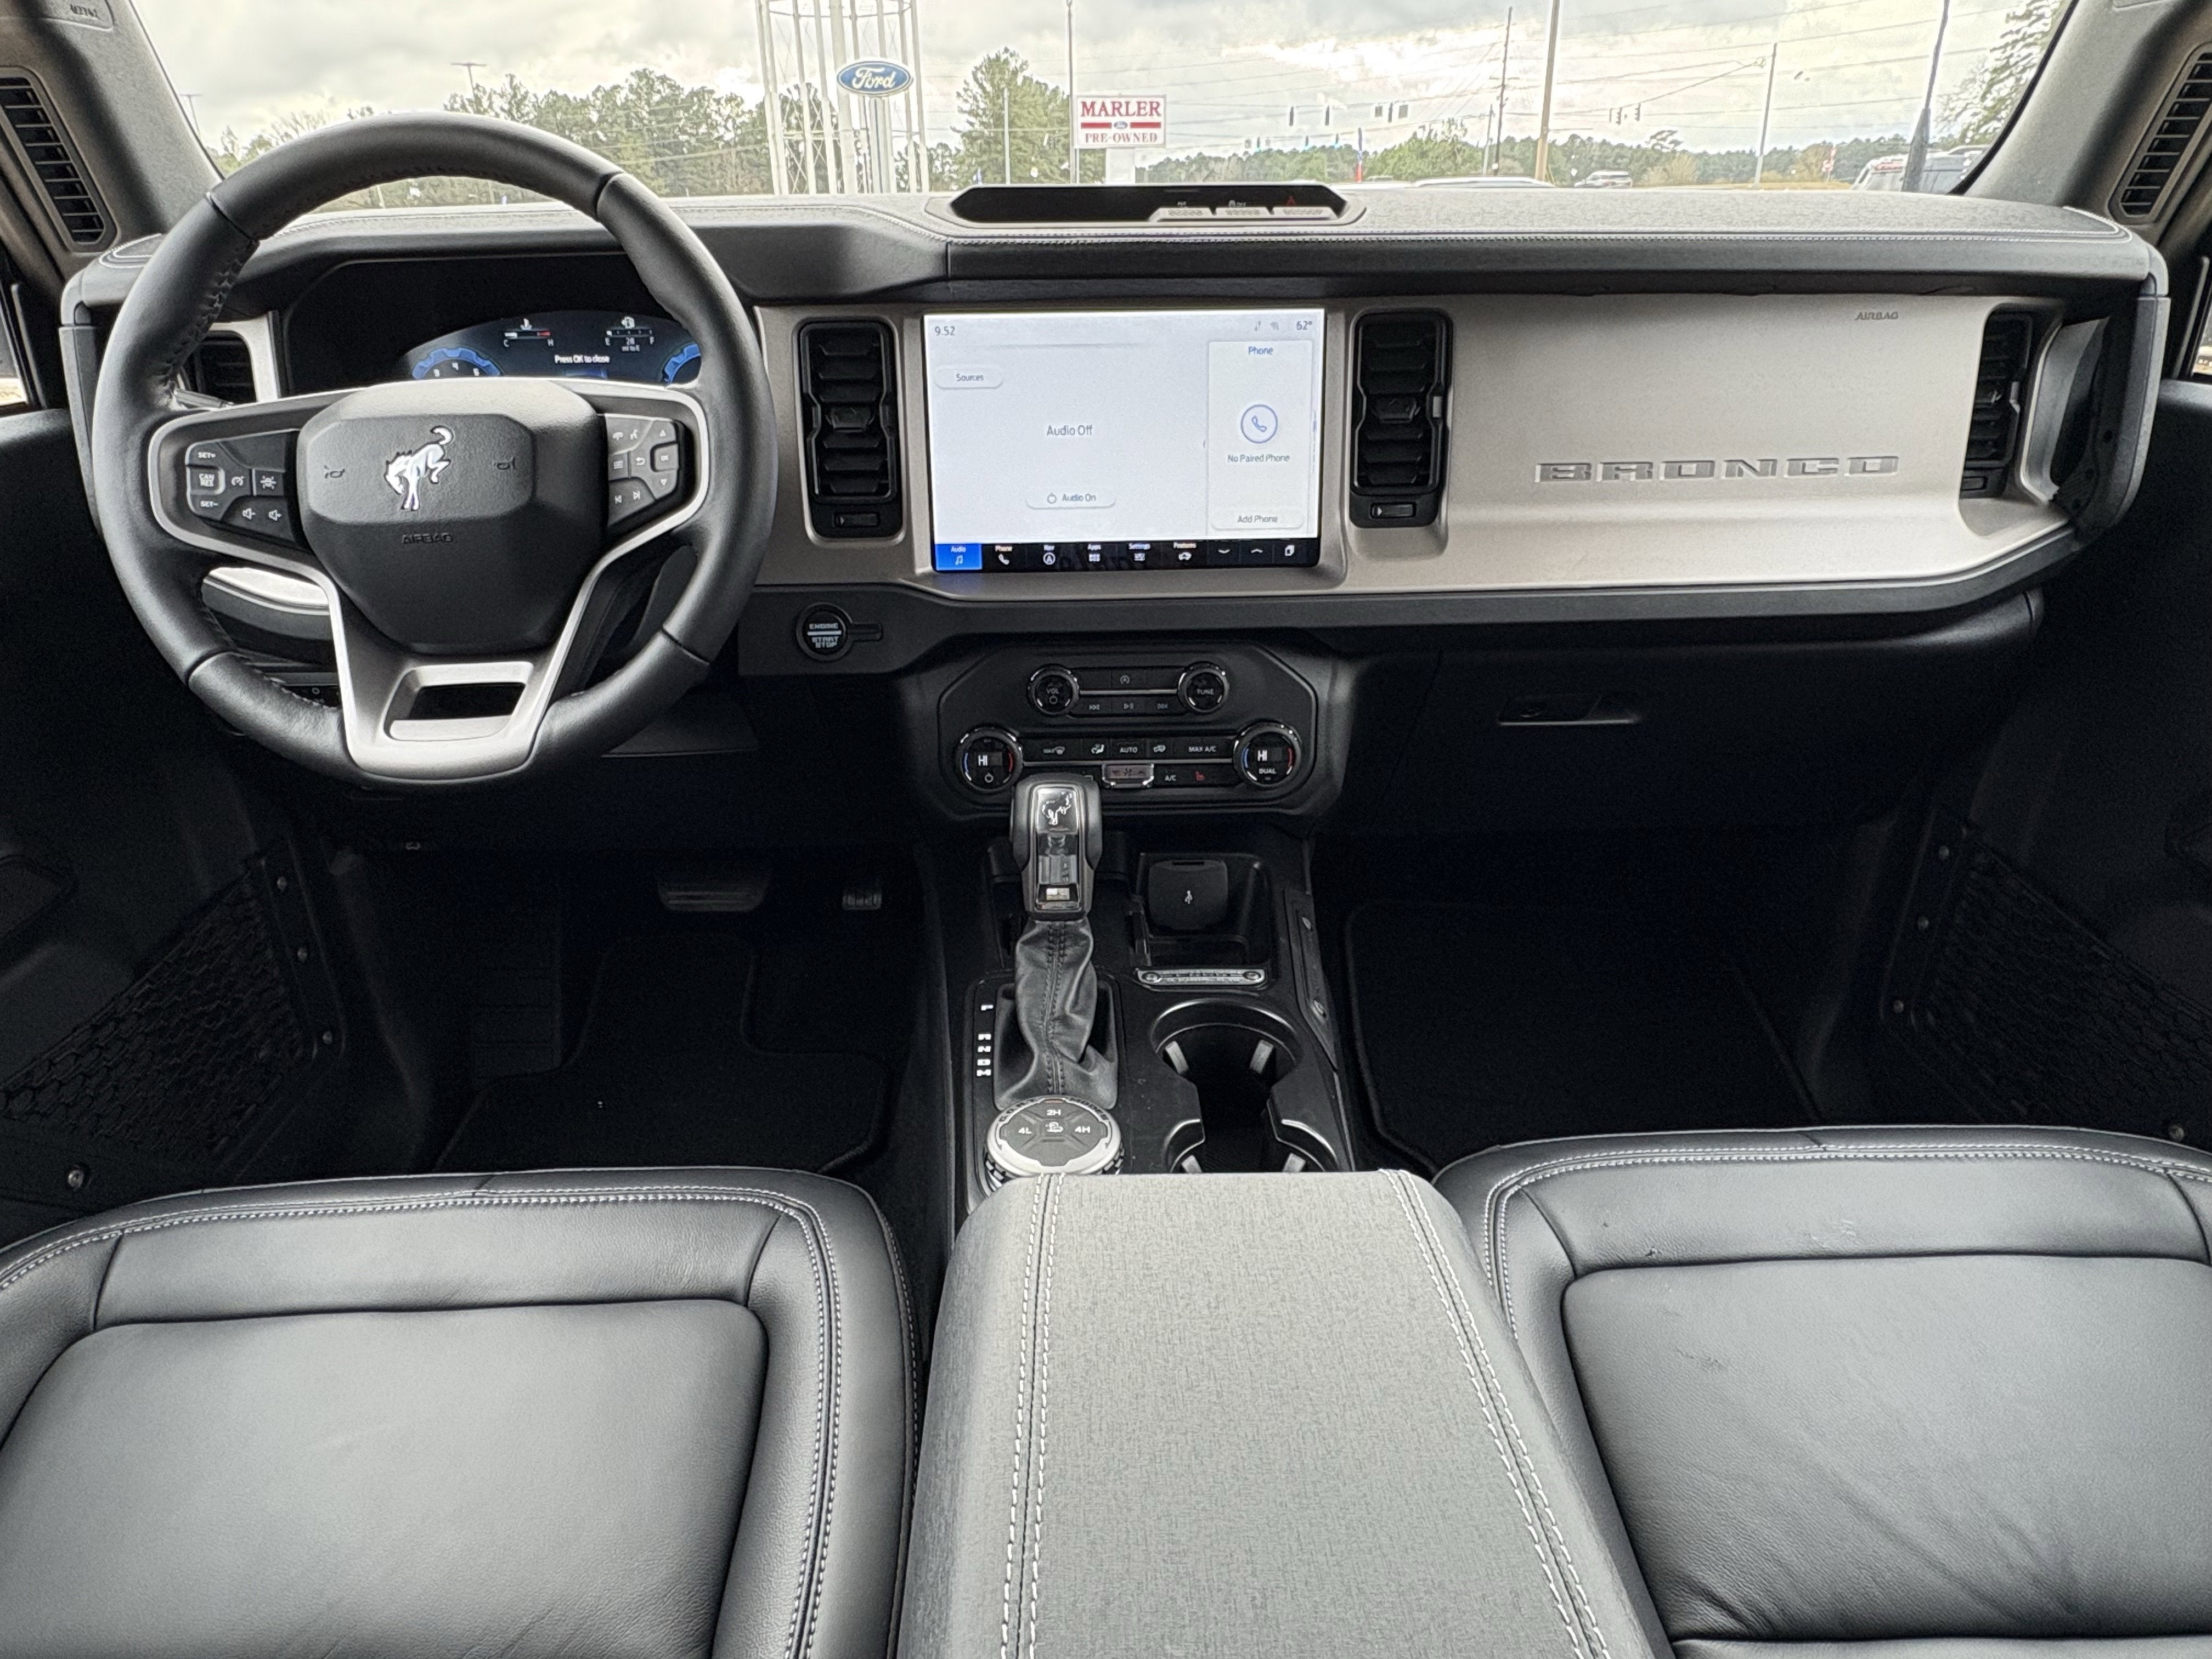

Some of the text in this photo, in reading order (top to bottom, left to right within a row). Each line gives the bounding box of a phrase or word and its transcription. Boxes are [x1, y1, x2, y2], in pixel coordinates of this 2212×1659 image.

[852, 67, 896, 89] Ford
[1080, 101, 1162, 117] MARLER
[1085, 133, 1158, 143] PRE-OWNED
[1854, 311, 1898, 320] AIRBAG
[1248, 346, 1274, 355] Phone
[554, 354, 573, 364] Press
[573, 354, 584, 363] OK
[956, 373, 984, 382] Sources
[1047, 424, 1093, 436] Audio Off
[1227, 454, 1290, 462] No Paired Phone
[1534, 455, 1899, 483] BRONCO
[1062, 493, 1096, 502] Audio On
[1237, 515, 1278, 523] Add Phone
[1257, 749, 1267, 761] HI
[978, 754, 988, 767] HI
